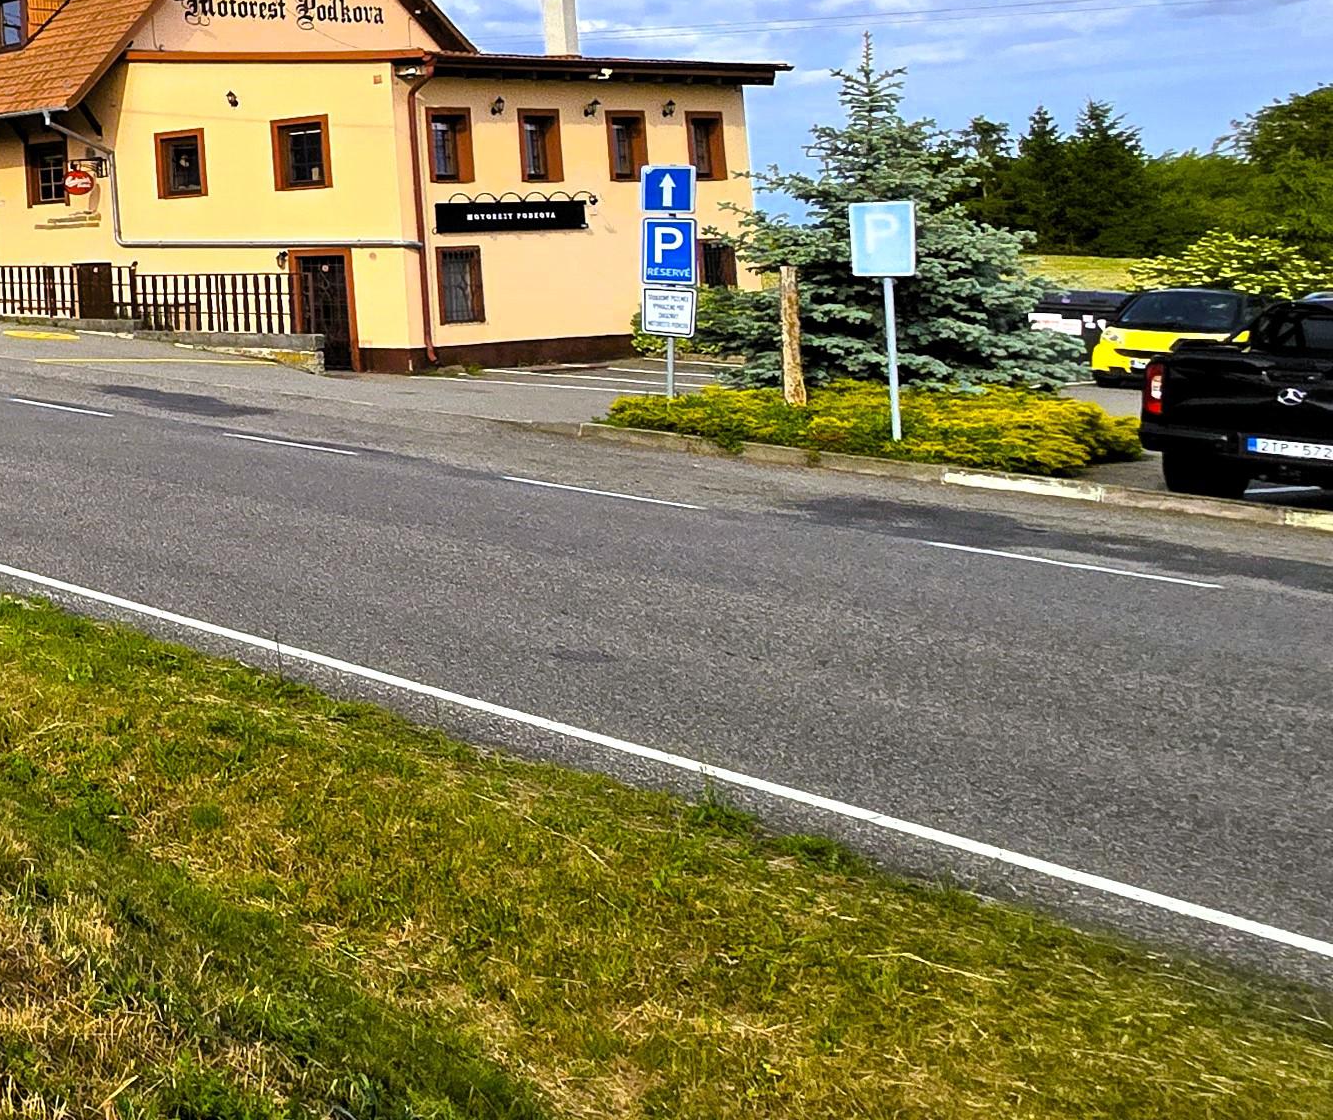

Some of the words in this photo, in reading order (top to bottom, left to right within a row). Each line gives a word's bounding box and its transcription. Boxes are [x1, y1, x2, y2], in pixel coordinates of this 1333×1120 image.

[654, 226, 684, 263] P
[864, 213, 901, 254] P
[1261, 441, 1289, 452] 2TP
